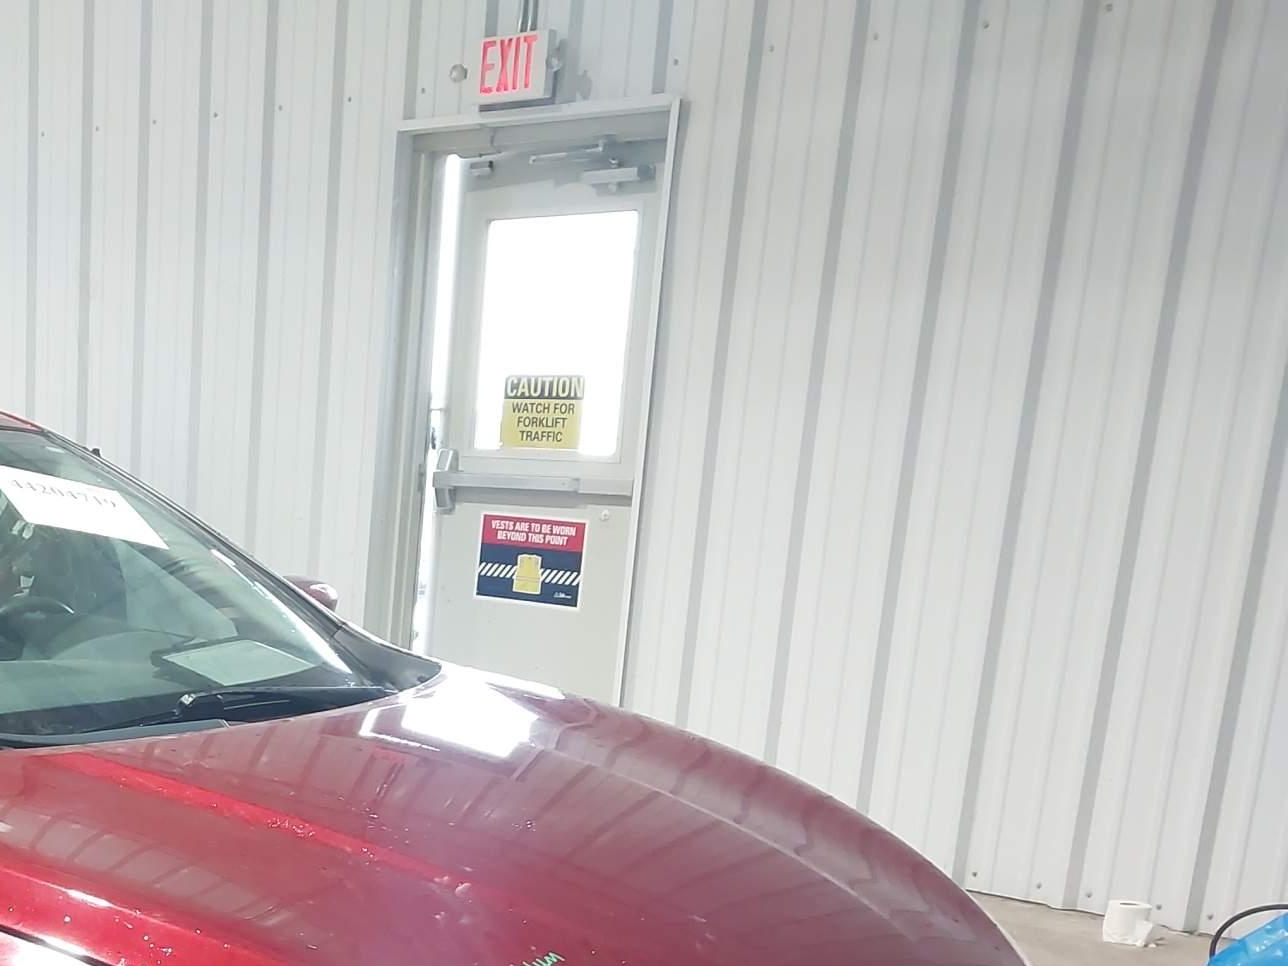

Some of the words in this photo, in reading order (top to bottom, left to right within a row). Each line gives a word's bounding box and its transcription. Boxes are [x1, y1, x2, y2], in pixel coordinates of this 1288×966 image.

[479, 34, 537, 94] EXIT
[506, 376, 584, 398] CAUTION
[512, 402, 550, 414] WATCH
[553, 403, 575, 415] FOR
[517, 416, 568, 428] FORKLIFT
[520, 430, 563, 442] TRAFFIC
[491, 519, 514, 530] VESTS
[514, 522, 530, 532] ARE
[531, 523, 541, 533] TO
[541, 524, 553, 534] BE
[552, 525, 577, 537] WORN
[497, 530, 527, 541] BEYOND
[528, 533, 545, 544] THIS
[545, 535, 569, 546] POINT
